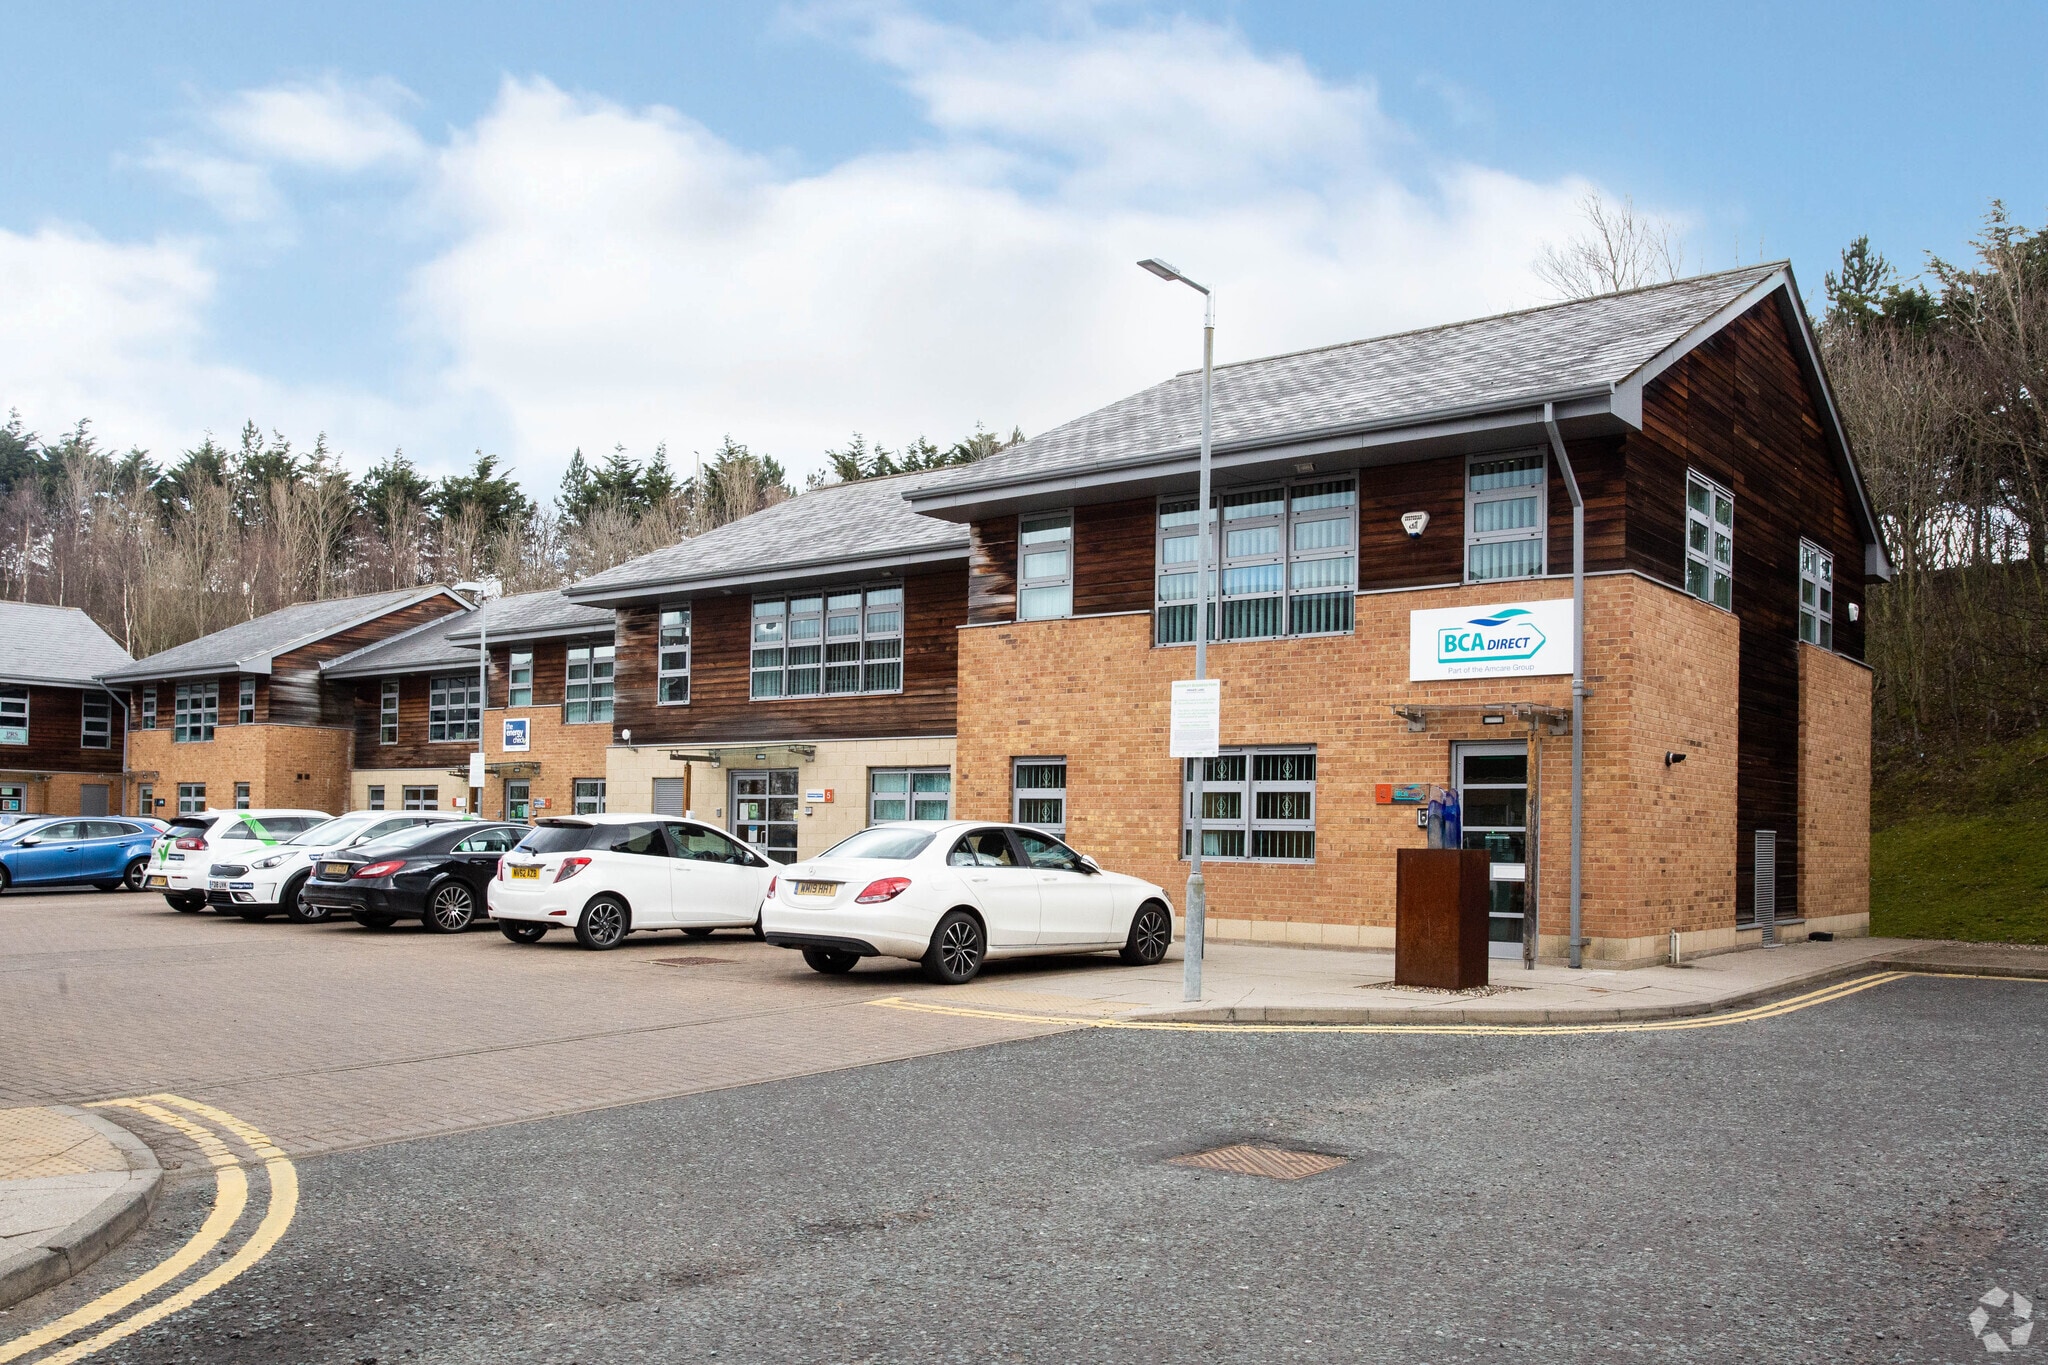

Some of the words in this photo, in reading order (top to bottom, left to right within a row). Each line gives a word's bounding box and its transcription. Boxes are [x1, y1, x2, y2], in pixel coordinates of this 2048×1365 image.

[1444, 632, 1485, 652] BCA
[1487, 637, 1530, 650] DIRECT
[1448, 666, 1462, 675] Part
[1463, 666, 1471, 674] of
[1472, 665, 1483, 673] the
[1484, 664, 1511, 673] Amcare
[1512, 663, 1535, 673] Group
[506, 729, 524, 738] energy
[827, 791, 831, 799] 5
